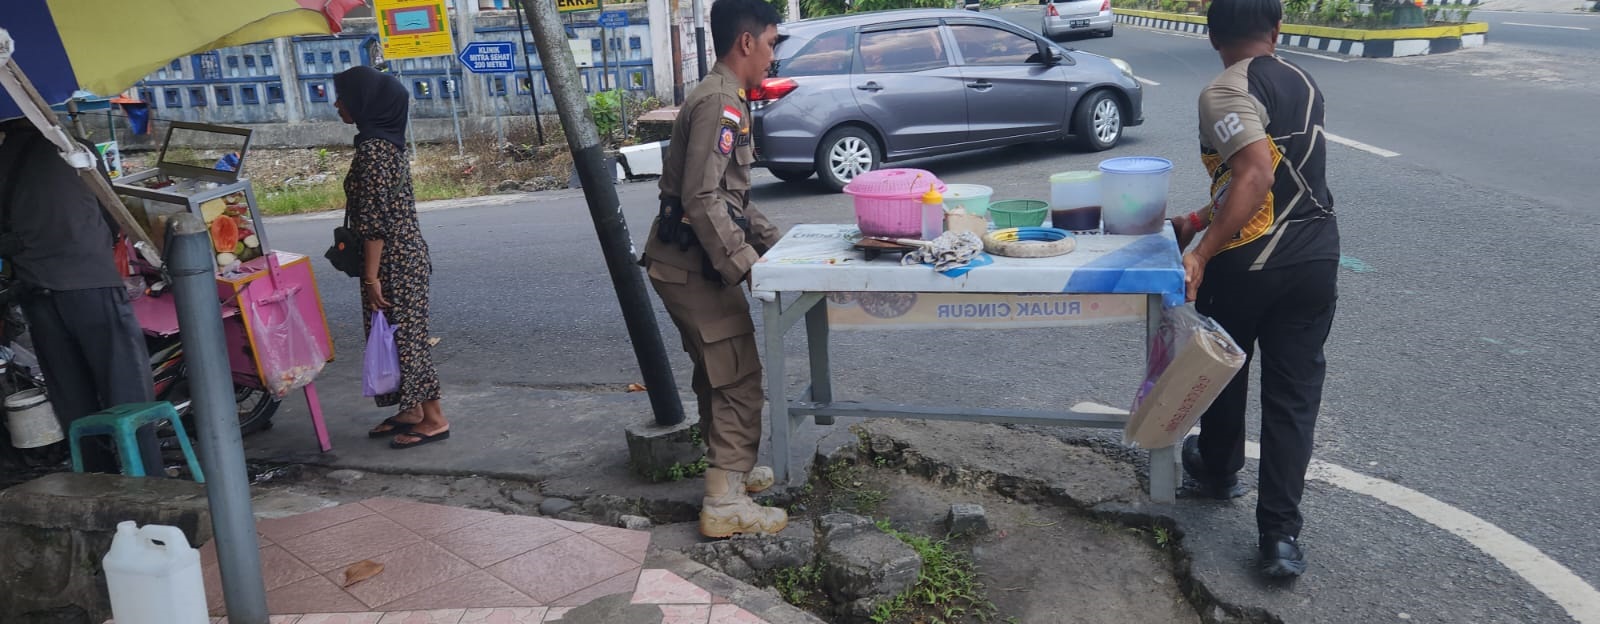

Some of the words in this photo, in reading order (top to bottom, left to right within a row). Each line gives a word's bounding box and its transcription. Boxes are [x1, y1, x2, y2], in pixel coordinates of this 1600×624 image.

[478, 46, 501, 54] KLINIK
[469, 54, 490, 62] MITRA
[490, 53, 510, 61] SEHAT
[486, 60, 508, 68] METER
[1214, 112, 1245, 143] 02
